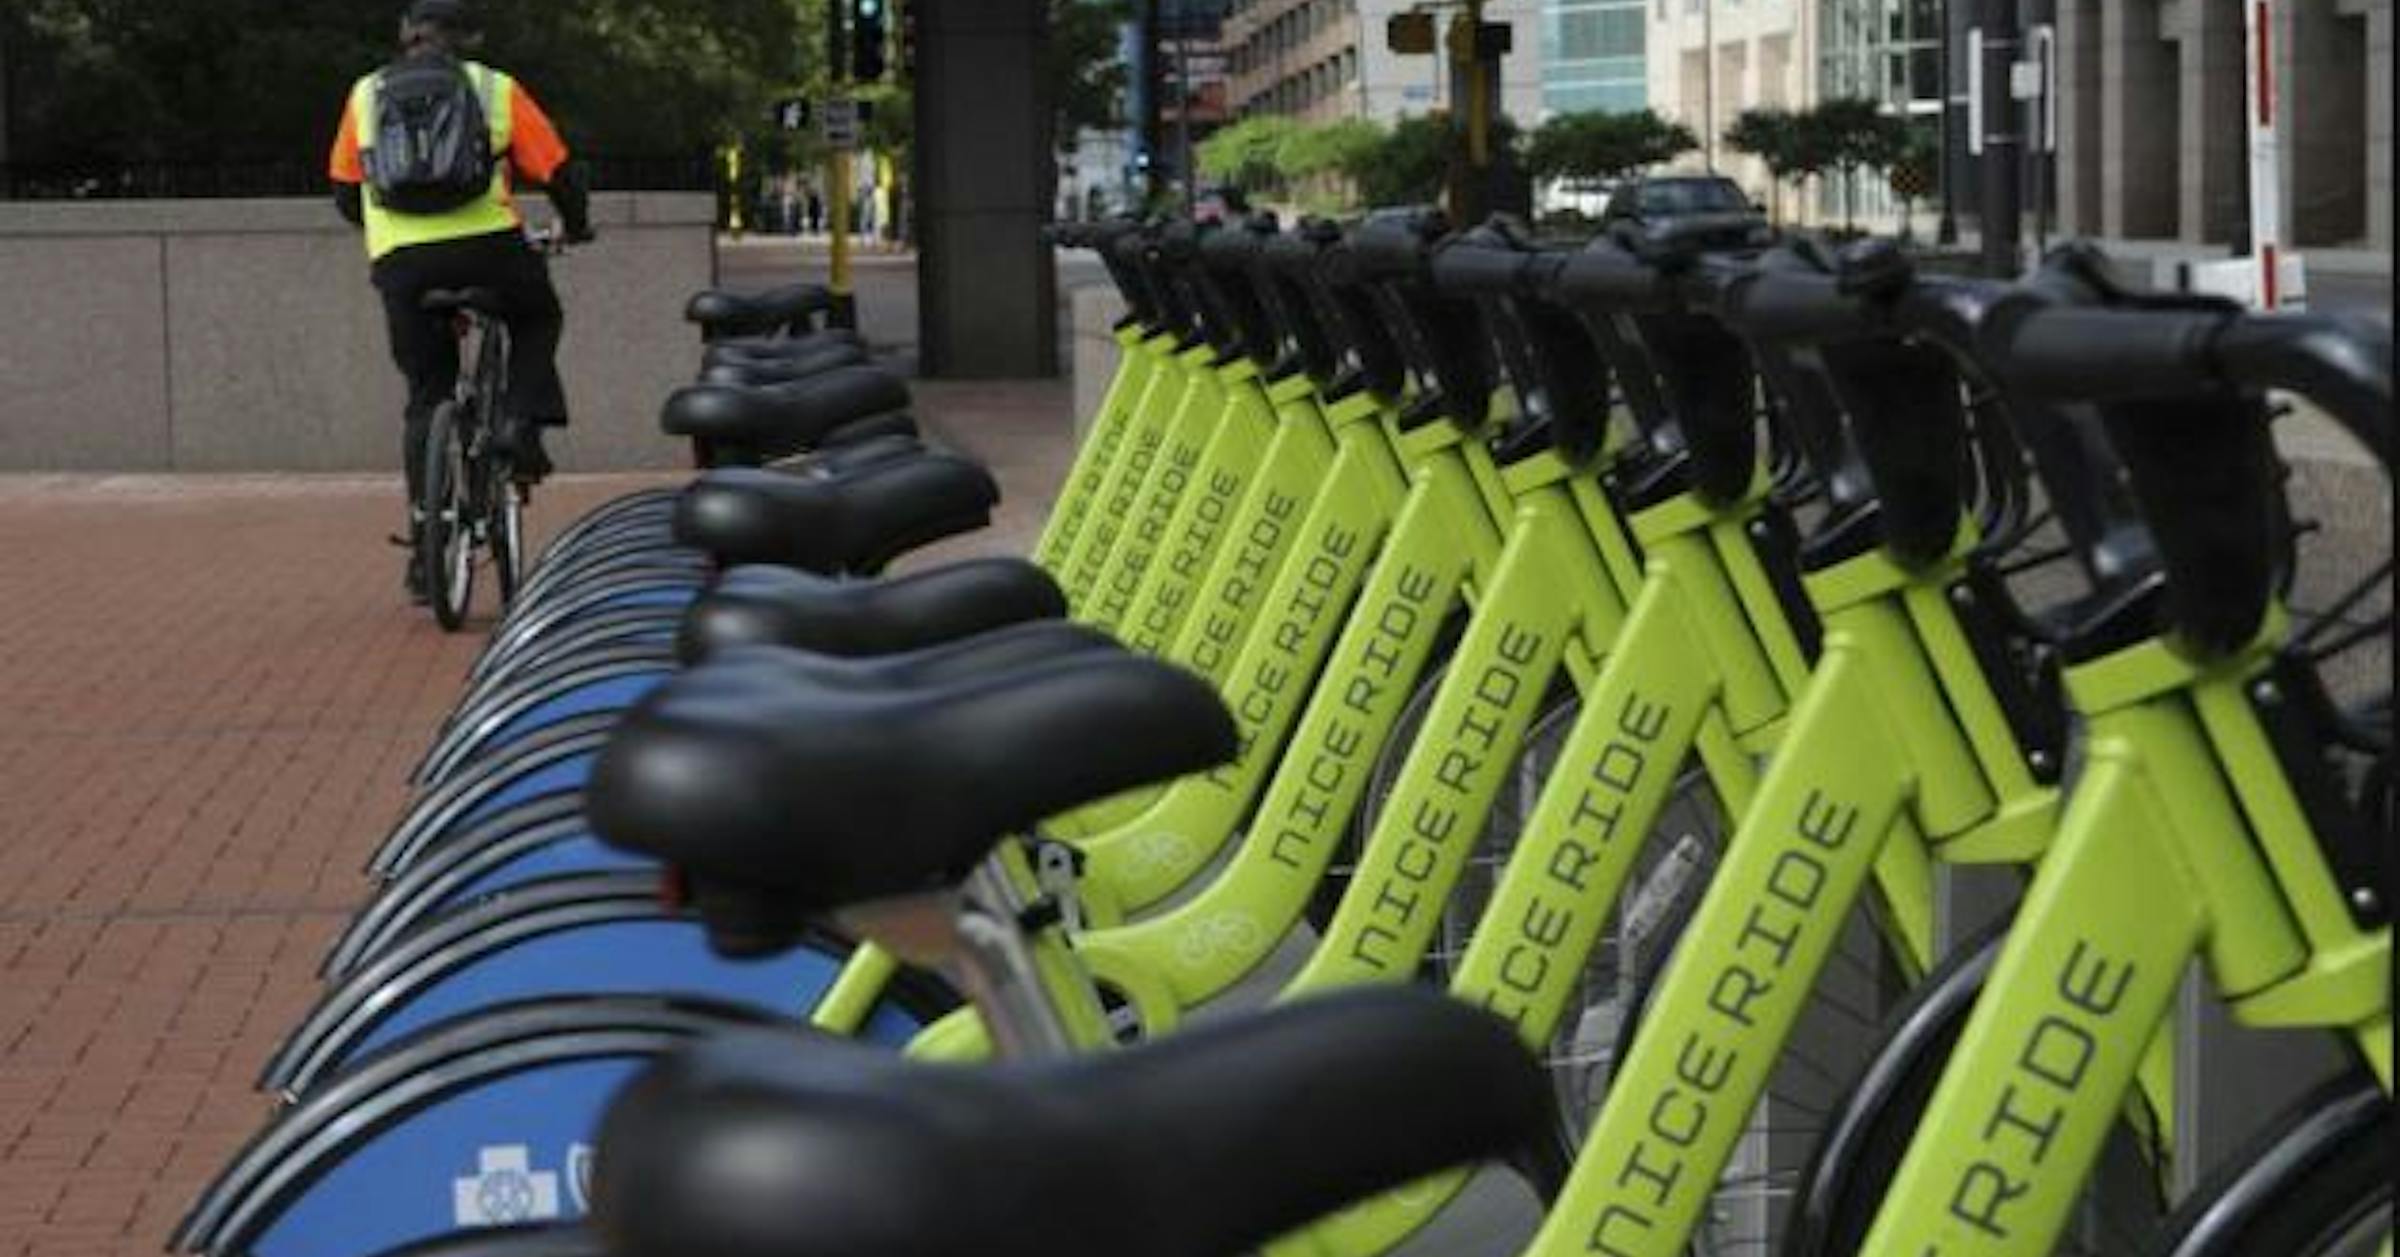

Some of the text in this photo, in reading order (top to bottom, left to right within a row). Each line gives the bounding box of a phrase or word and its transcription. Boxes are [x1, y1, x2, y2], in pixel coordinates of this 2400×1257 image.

[1100, 442, 1197, 616] ICE RIDE
[1109, 430, 1162, 517] RIDE
[1135, 465, 1239, 652] ICE RIDE
[1192, 490, 1295, 672] CE RIDE
[1276, 521, 1357, 654] RIDE
[1272, 564, 1434, 868] NICE RIDE
[1351, 621, 1542, 969] NICE RIDE
[1487, 692, 1672, 1019] CE RIDE
[1585, 790, 1859, 1257] NICE RIDE
[1949, 938, 2134, 1238] RIDE
